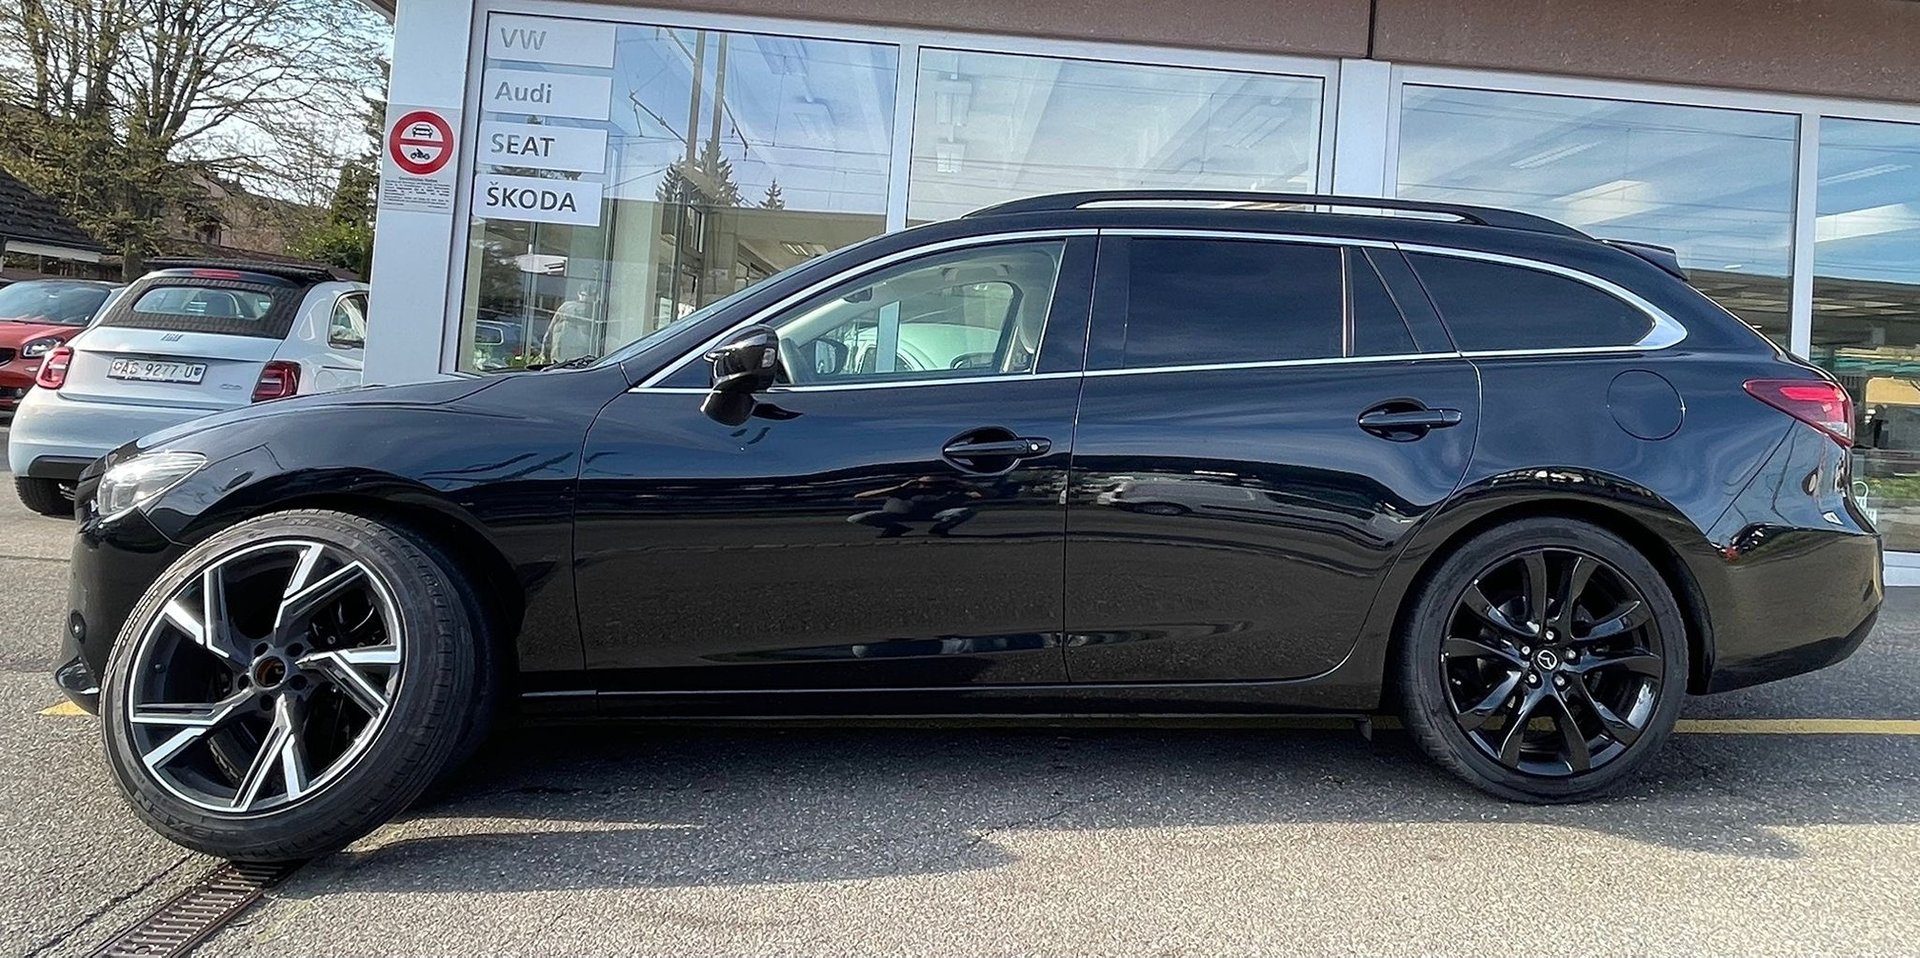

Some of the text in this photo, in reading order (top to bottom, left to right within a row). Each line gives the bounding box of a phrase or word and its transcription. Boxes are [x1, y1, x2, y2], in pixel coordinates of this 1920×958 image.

[500, 27, 546, 50] VW
[494, 81, 552, 104] Audi
[490, 133, 555, 157] SEAT
[485, 181, 577, 212] ŠKODA
